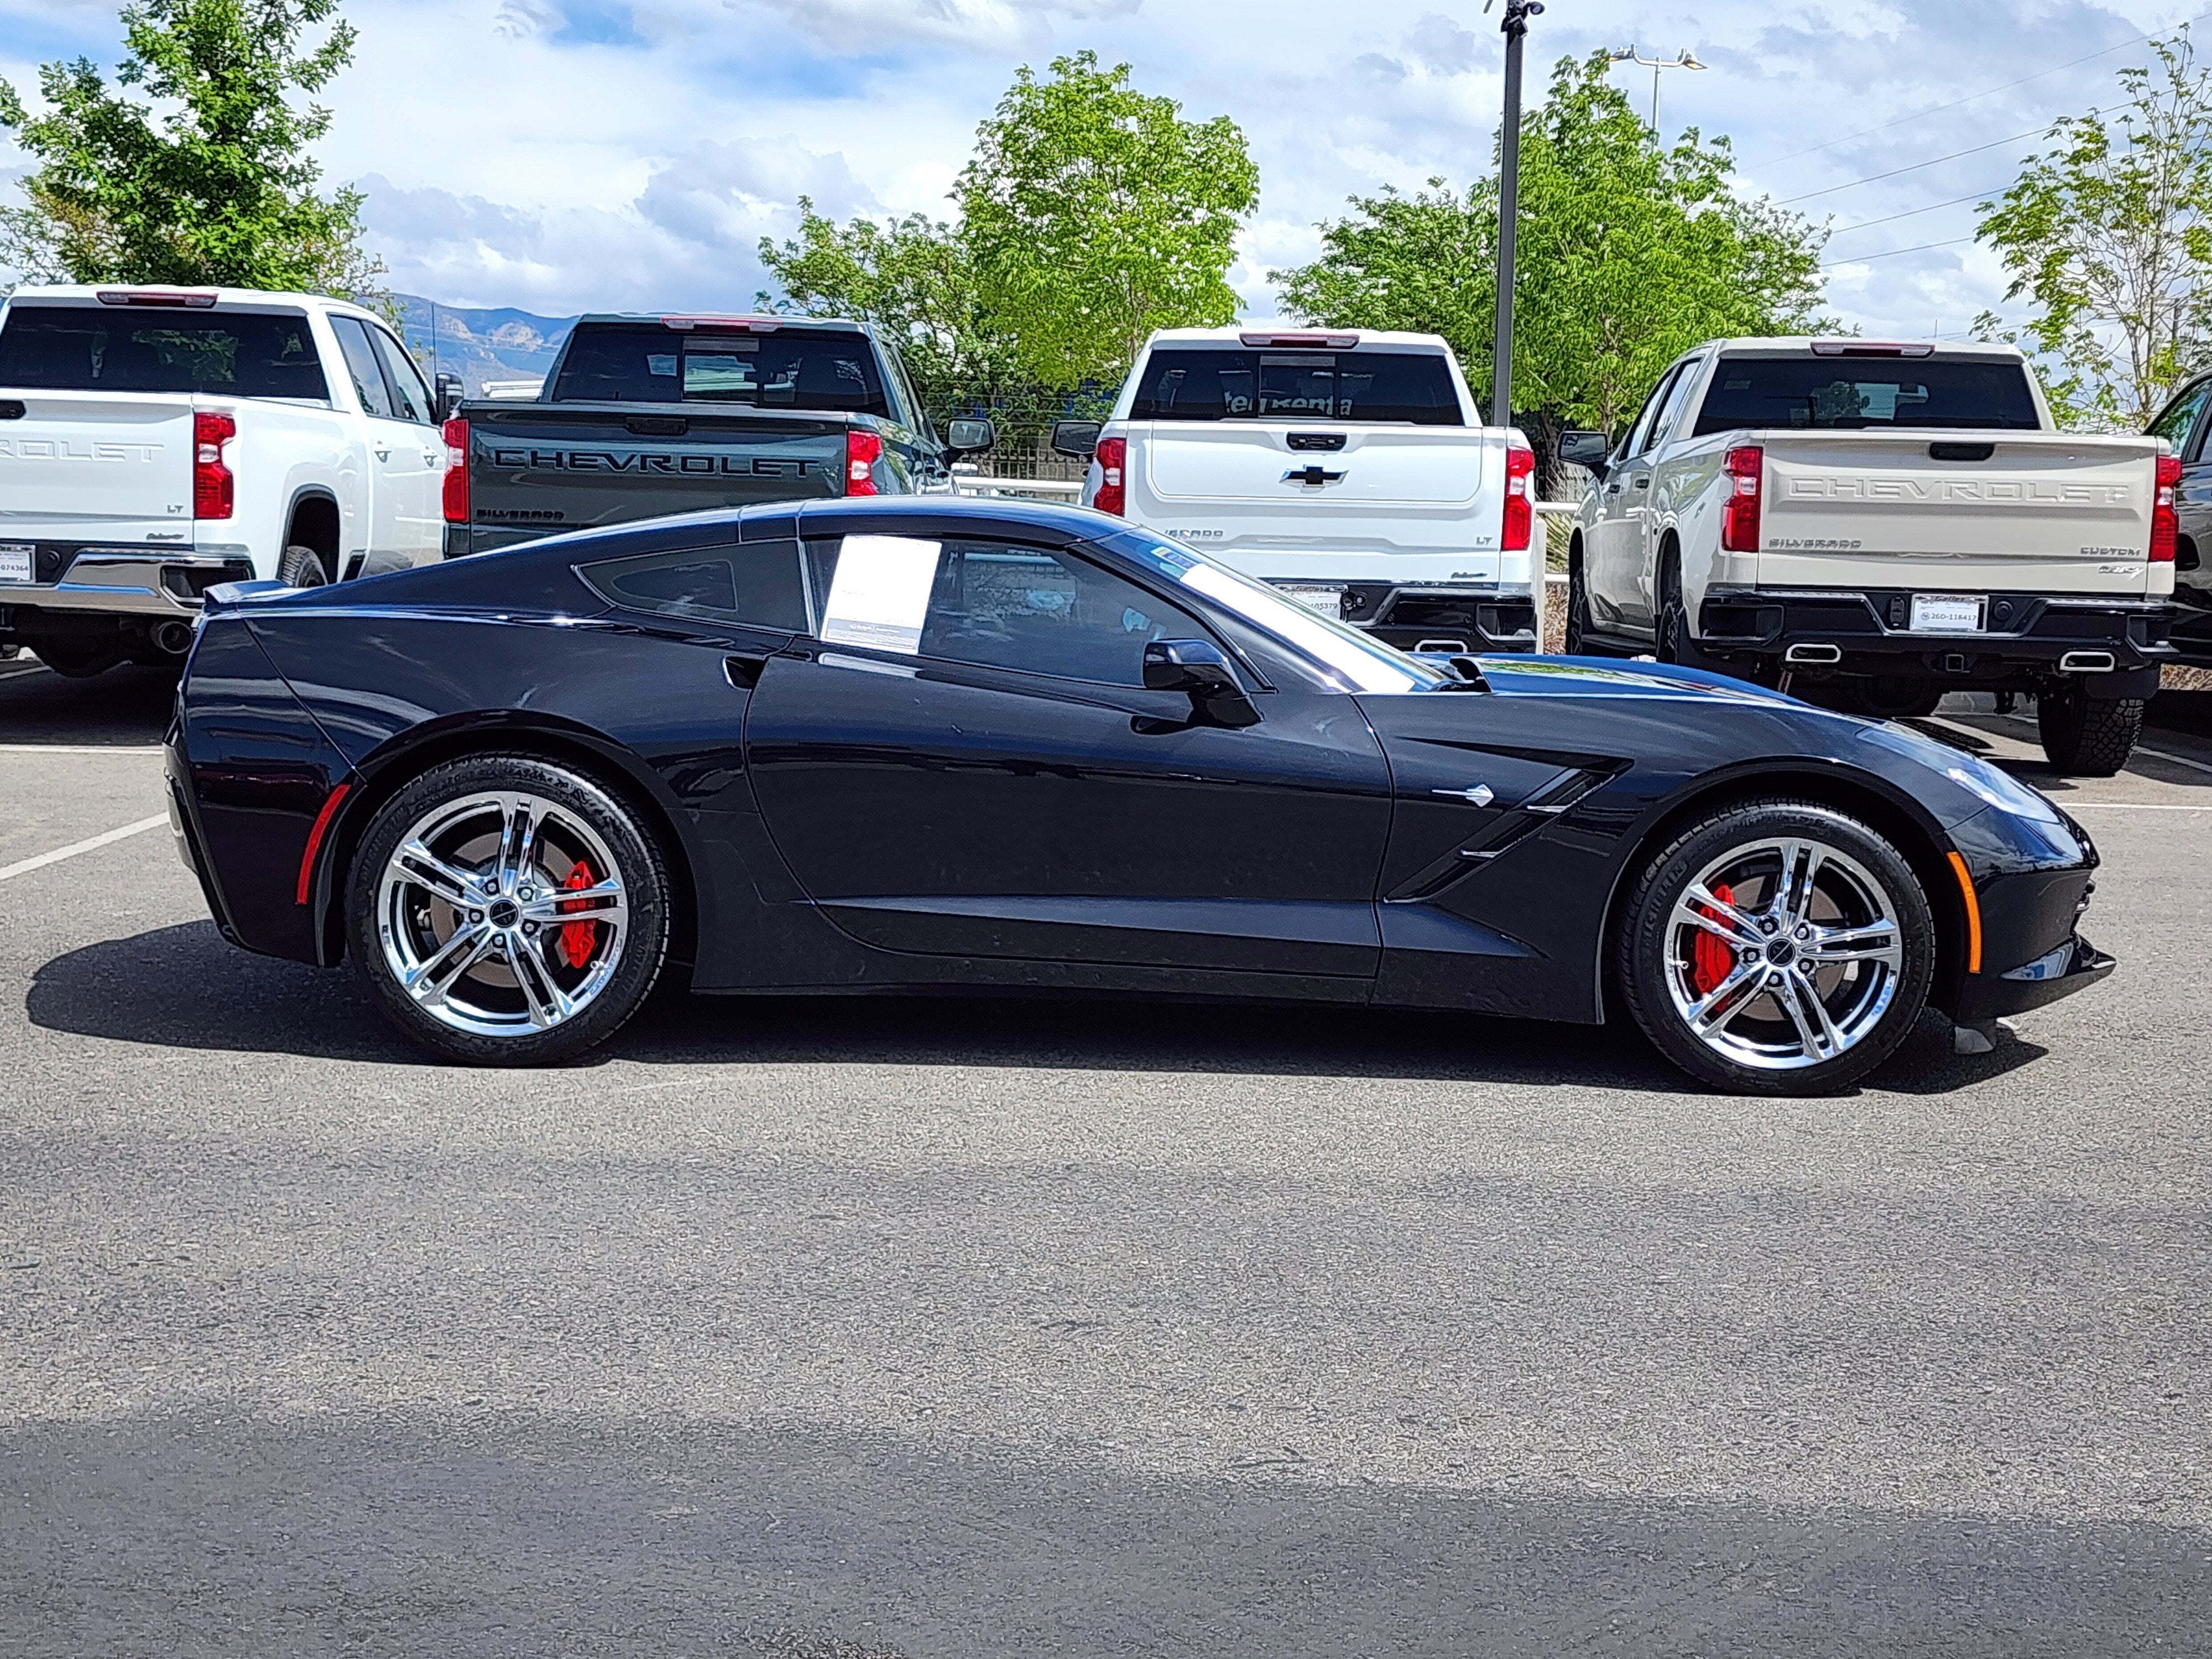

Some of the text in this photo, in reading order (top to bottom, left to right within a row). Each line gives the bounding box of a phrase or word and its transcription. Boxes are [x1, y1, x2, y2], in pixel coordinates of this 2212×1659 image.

[494, 450, 820, 478] CHEVROLET
[1788, 478, 2128, 503] CHEVROLET
[167, 505, 184, 513] LT
[477, 509, 565, 521] SILVERADO
[1476, 536, 1493, 545] LT
[1769, 539, 1862, 549] SILVERADO
[2080, 547, 2141, 556] CUSTOM
